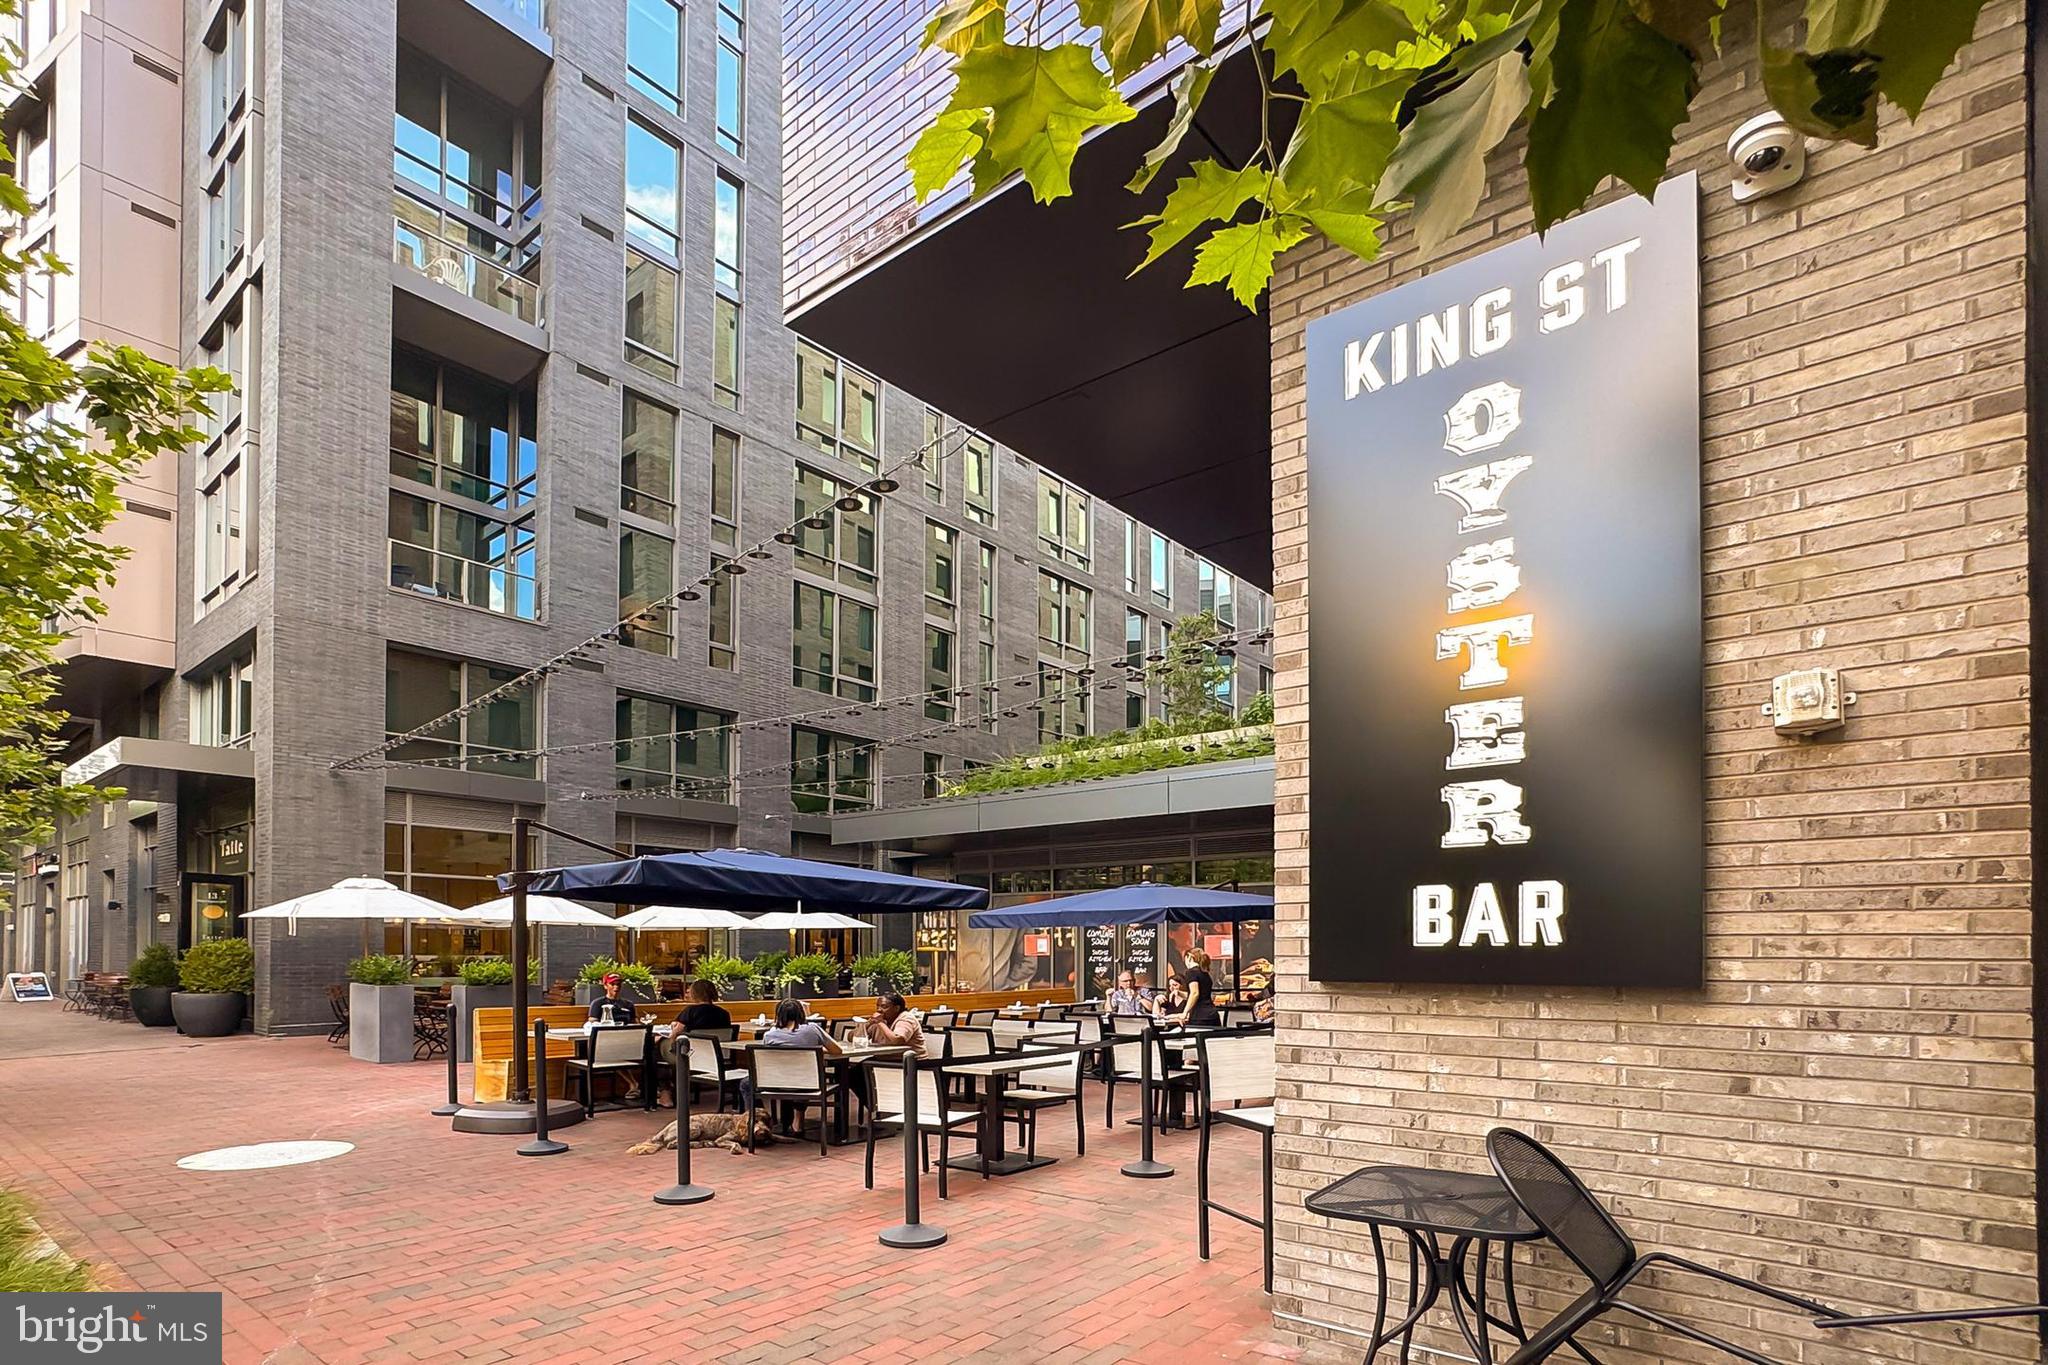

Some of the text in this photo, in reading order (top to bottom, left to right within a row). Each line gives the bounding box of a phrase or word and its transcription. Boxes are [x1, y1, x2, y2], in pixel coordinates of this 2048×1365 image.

[1344, 237, 1641, 401] KING ST
[1433, 380, 1535, 849] OYSTER
[1413, 880, 1564, 947] BAR
[1086, 929, 1114, 938] COMING
[1126, 929, 1156, 938] COMING
[1091, 938, 1110, 946] SOON
[1131, 938, 1151, 946] SOON
